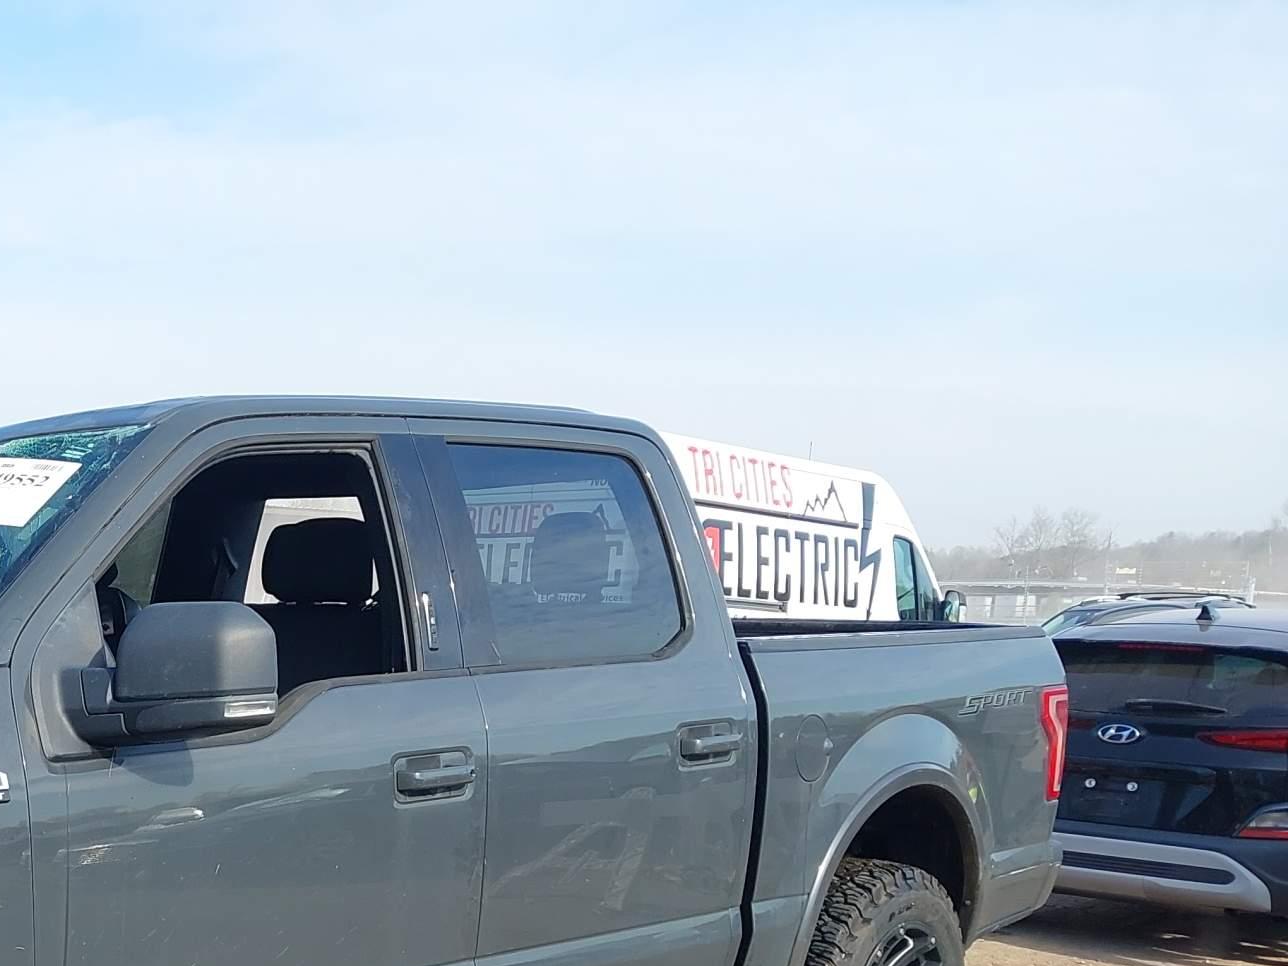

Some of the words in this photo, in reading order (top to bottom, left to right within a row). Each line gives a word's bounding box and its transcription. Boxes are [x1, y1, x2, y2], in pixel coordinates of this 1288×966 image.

[688, 446, 724, 497] TRI
[729, 455, 794, 508] CITIES
[718, 519, 859, 608] ELECTRIC
[958, 690, 1032, 717] SPORT
